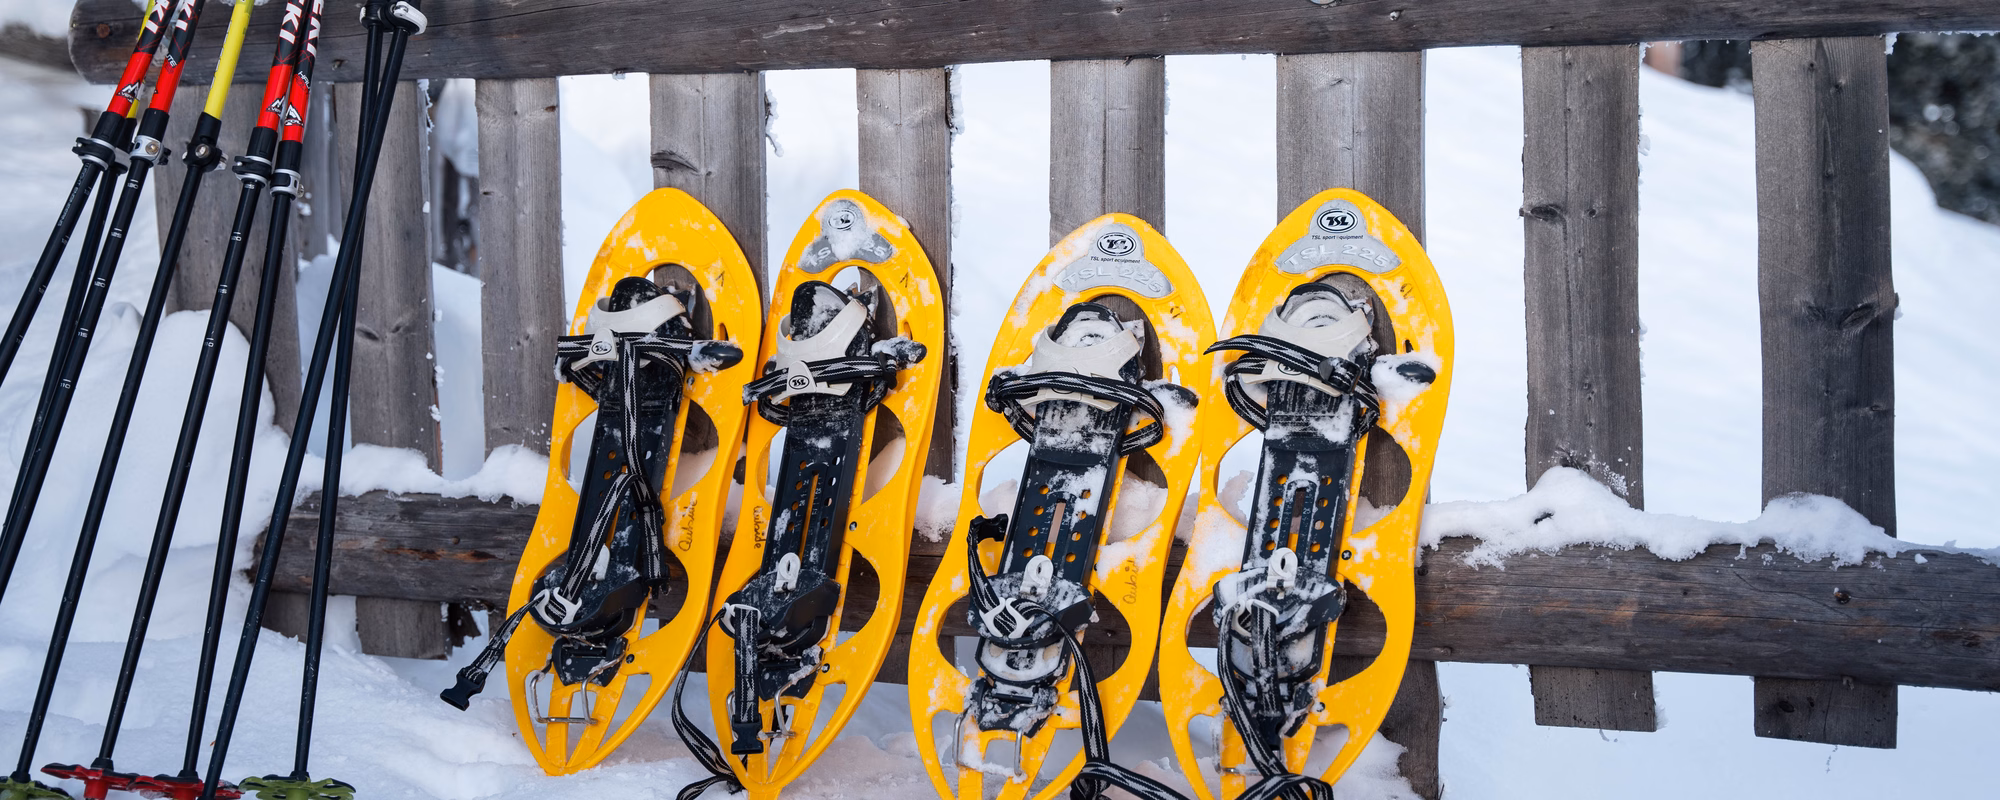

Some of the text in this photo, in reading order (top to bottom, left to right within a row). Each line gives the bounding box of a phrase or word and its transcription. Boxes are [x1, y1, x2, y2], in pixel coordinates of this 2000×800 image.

[279, 0, 304, 45] KI
[1326, 215, 1349, 226] TSL
[1284, 244, 1390, 268] TSL 225
[1062, 265, 1164, 293] TSL 225
[792, 378, 806, 387] TSL
